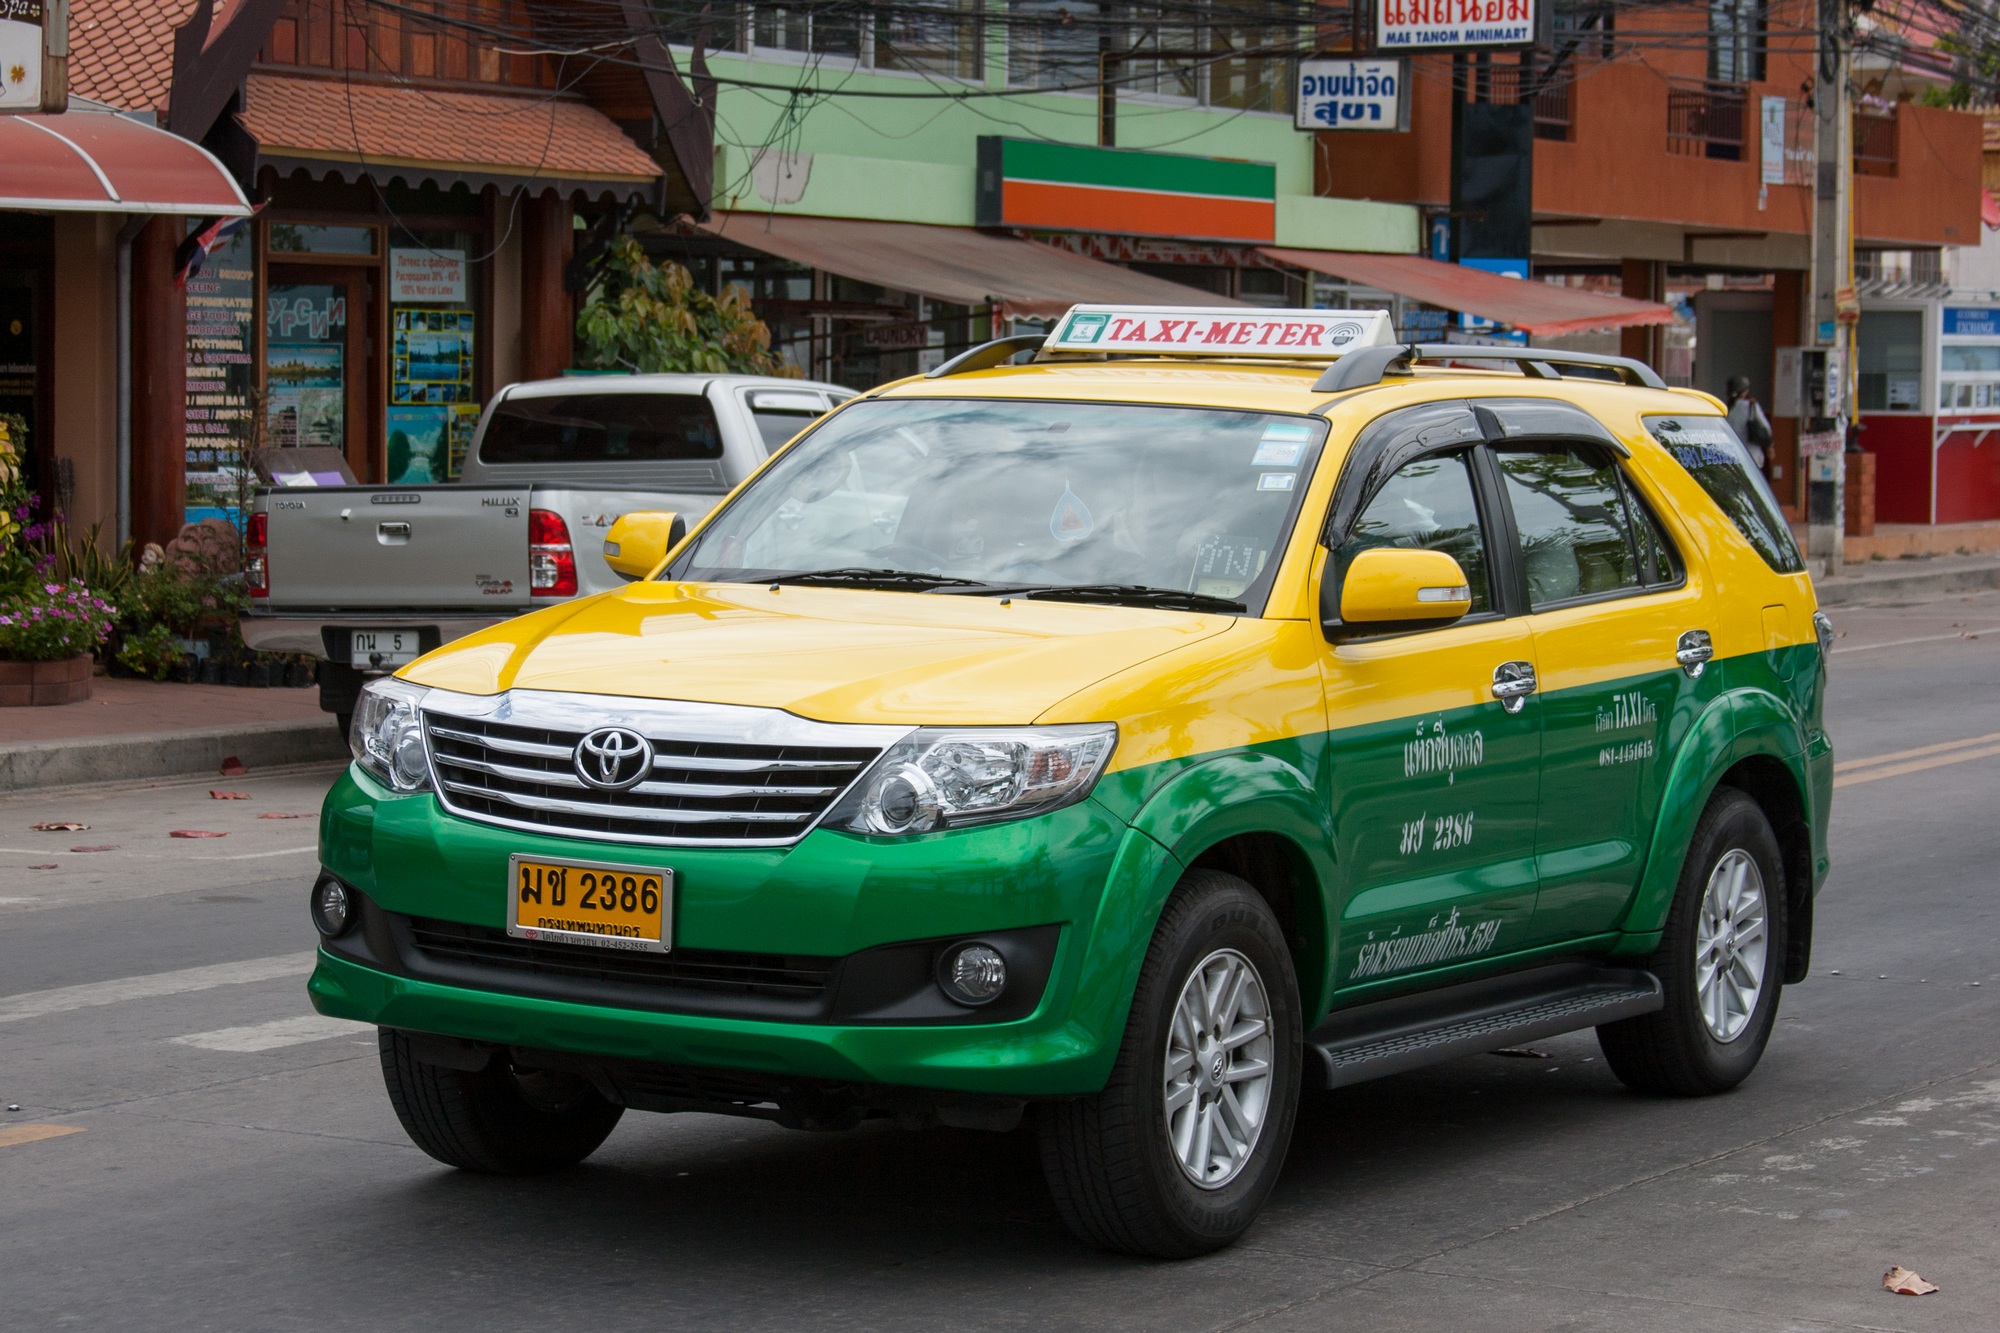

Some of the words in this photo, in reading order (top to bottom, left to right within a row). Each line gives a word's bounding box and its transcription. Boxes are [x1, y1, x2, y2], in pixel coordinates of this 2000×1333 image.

[1384, 0, 1529, 25] แมถนอม
[1386, 32, 1411, 44] MAE
[1416, 30, 1459, 42] TANOM
[1465, 27, 1527, 41] MINIMART
[1303, 62, 1395, 97] อาบน้ำจืด
[1314, 101, 1382, 126] สุขา
[203, 311, 229, 321] TOUR
[865, 325, 926, 344] LAUNDRY
[1108, 318, 1327, 347] TAXI-METER
[186, 381, 226, 392] MINIBUS
[205, 423, 229, 434] CALL
[276, 501, 305, 509] TOYOTA
[482, 498, 520, 506] HILUX
[356, 634, 376, 650] กน
[394, 634, 402, 650] 5
[1613, 691, 1642, 729] TAXI
[1599, 739, 1653, 767] 081-4451615
[1433, 811, 1474, 850] 2386
[521, 867, 568, 906] มช
[579, 873, 659, 914] 2386
[538, 916, 641, 938] กรงเทพมหานคร
[601, 940, 648, 951] 02-452-2555
